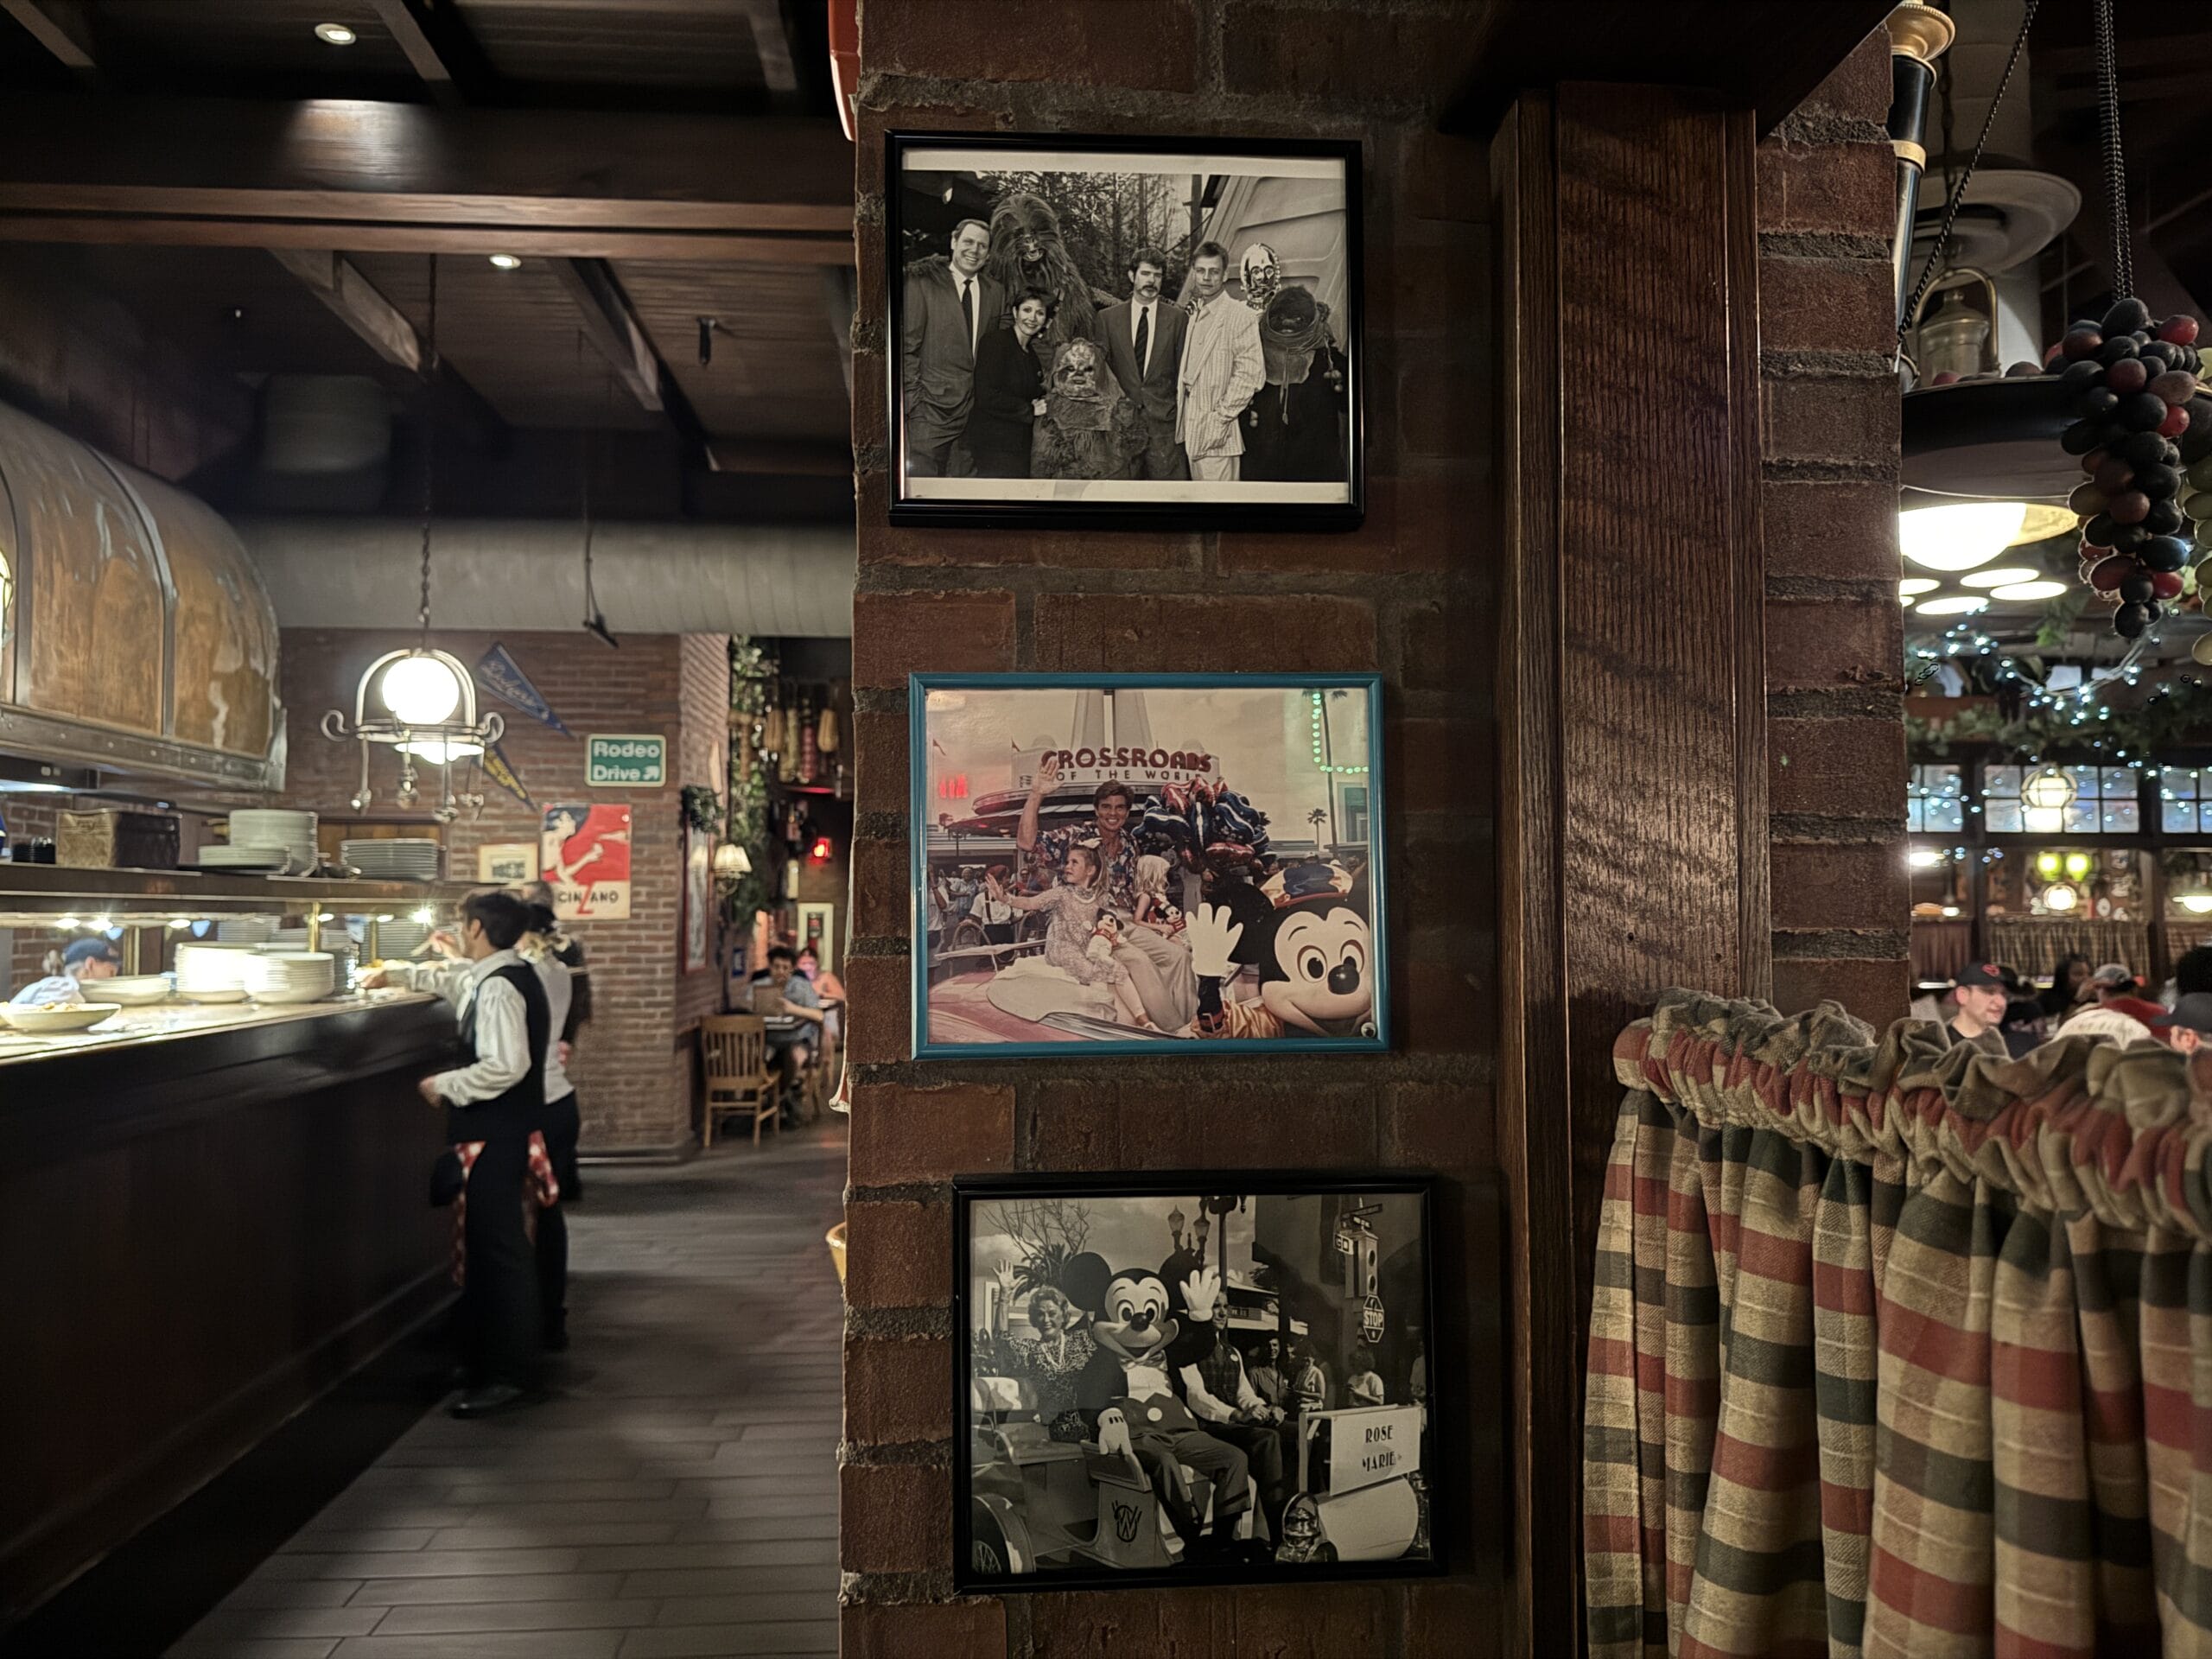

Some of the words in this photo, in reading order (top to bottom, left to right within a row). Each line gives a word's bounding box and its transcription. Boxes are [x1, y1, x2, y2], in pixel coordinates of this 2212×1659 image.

[593, 741, 660, 759] Rodeo
[1040, 747, 1211, 772] CROSSROADS
[592, 764, 641, 781] Drive
[1056, 771, 1077, 781] OF
[1095, 769, 1131, 780] THE
[1146, 769, 1201, 782] WORL
[558, 881, 620, 914] CINZANO
[1334, 1234, 1350, 1253] GO
[1363, 1309, 1383, 1327] STOP
[1365, 1424, 1394, 1444] ROSE
[1362, 1451, 1396, 1472] MARIE
